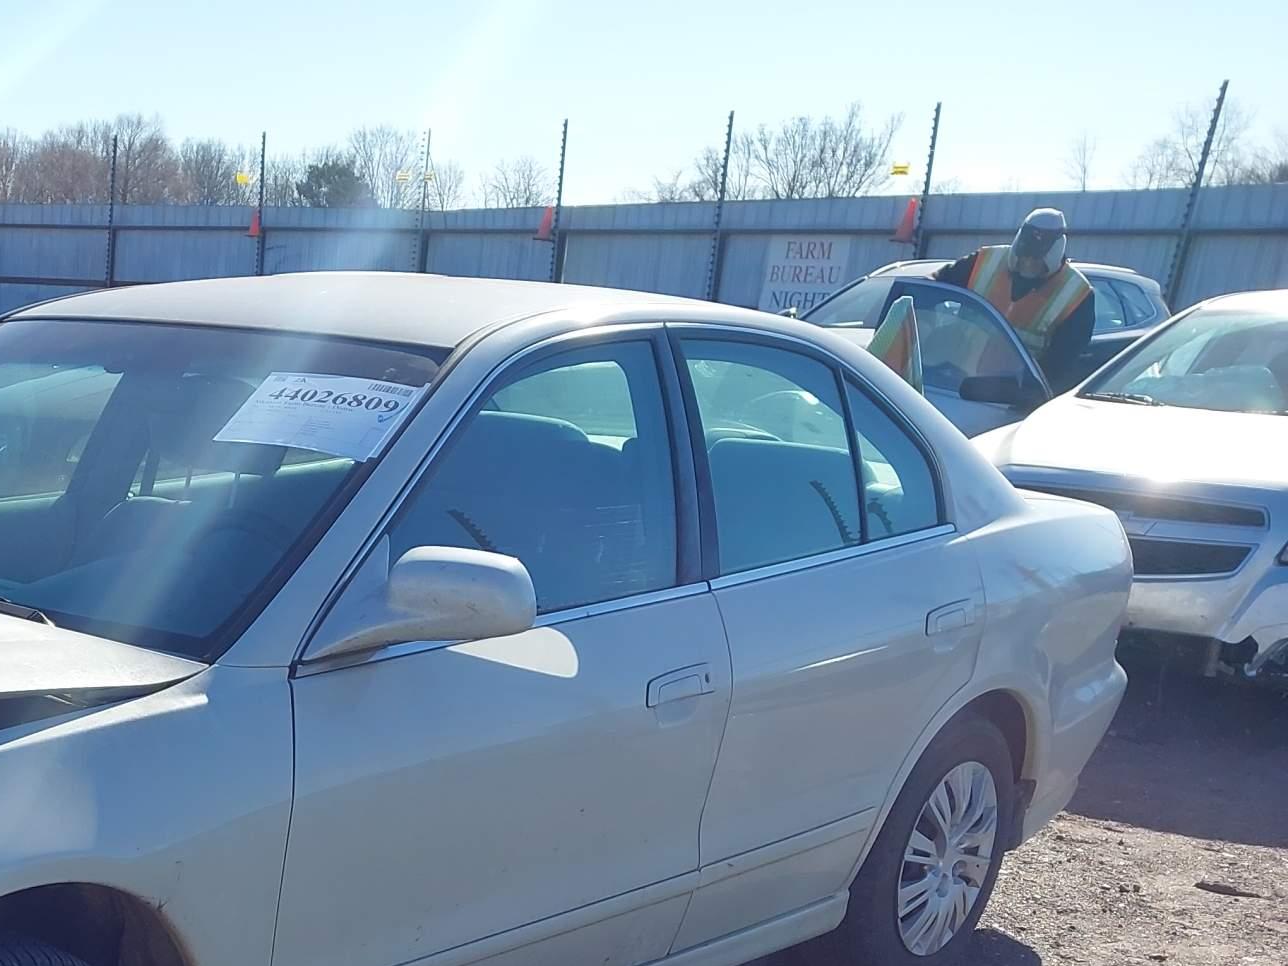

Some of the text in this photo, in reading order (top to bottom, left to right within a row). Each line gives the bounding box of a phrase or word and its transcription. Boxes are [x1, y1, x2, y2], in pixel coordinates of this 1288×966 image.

[785, 241, 832, 259] FARM
[770, 264, 841, 284] BUREAU
[268, 386, 400, 413] 44026809
